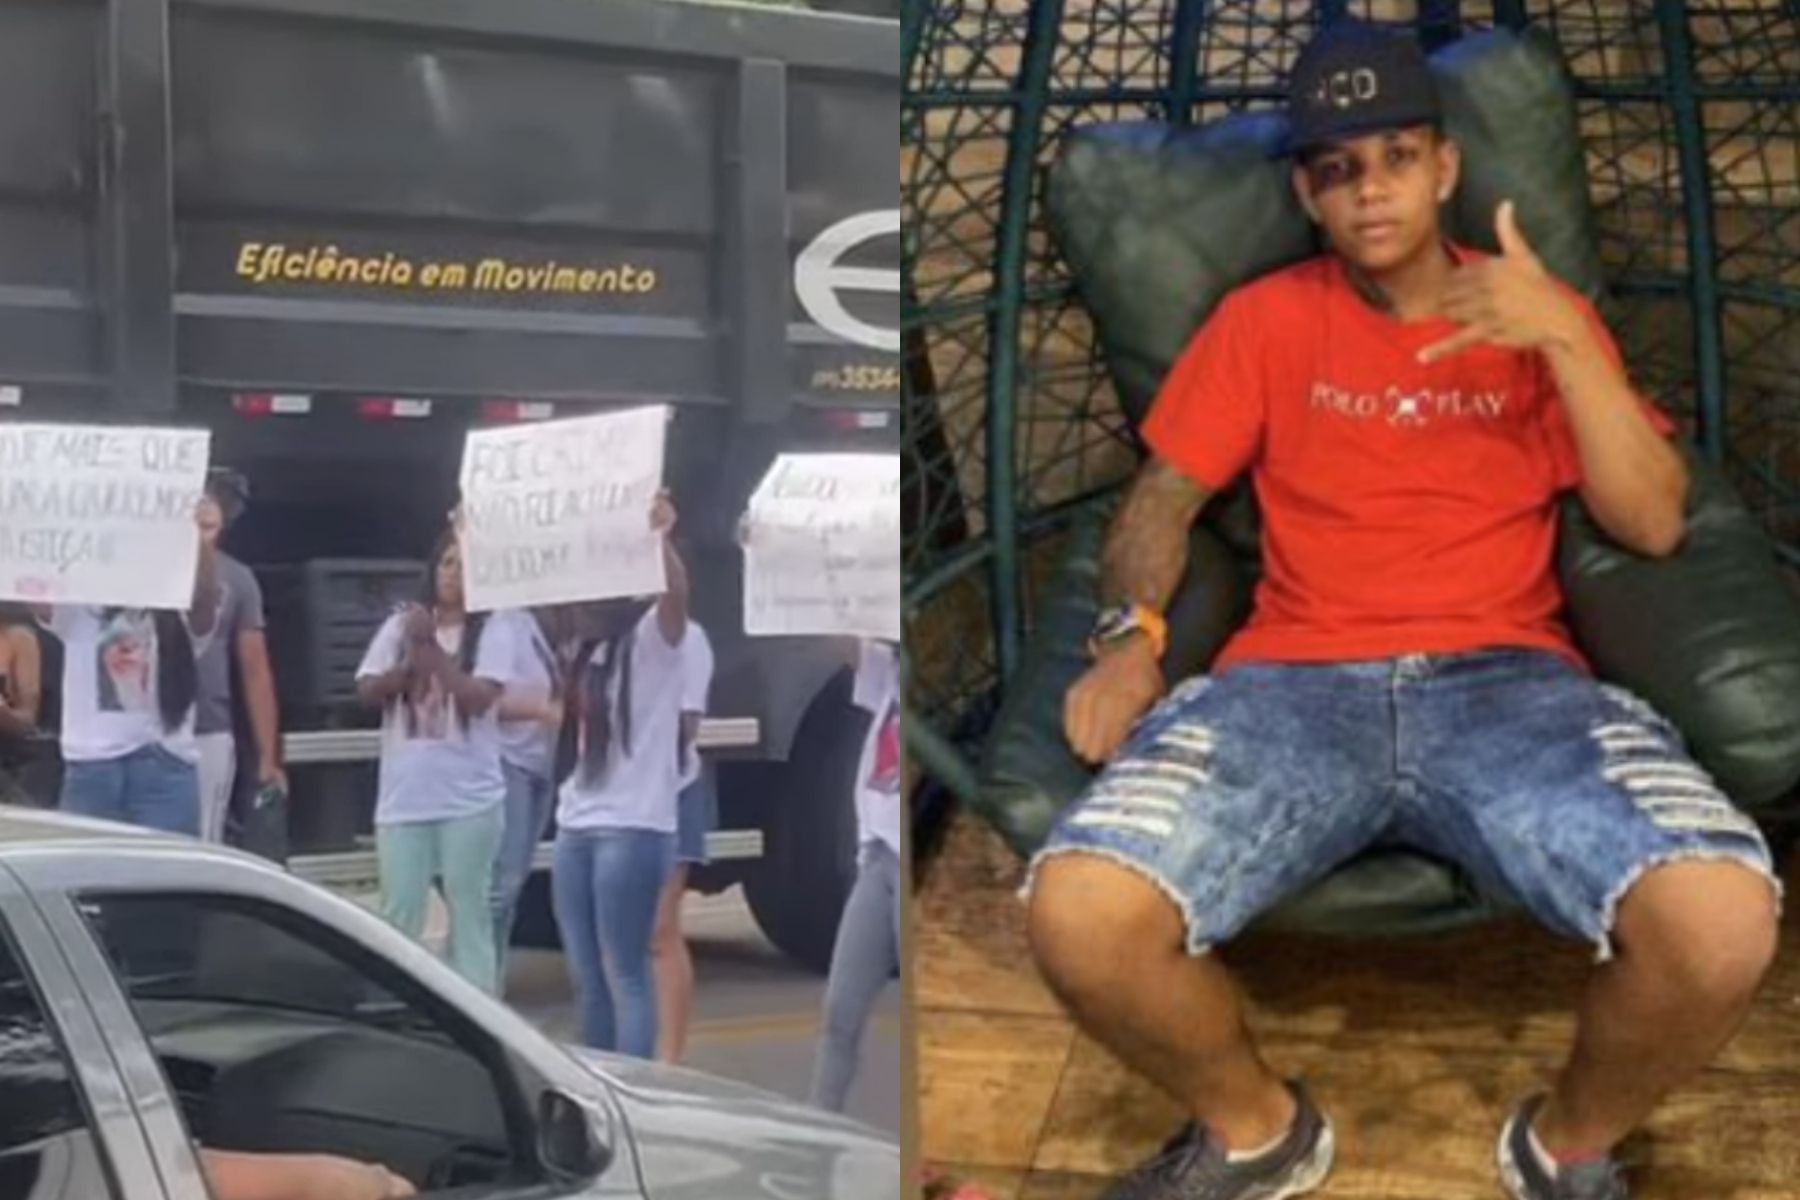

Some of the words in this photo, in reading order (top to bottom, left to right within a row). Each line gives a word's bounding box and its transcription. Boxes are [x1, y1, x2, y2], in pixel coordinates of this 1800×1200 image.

[236, 243, 412, 283] Eficiência
[420, 260, 467, 289] em
[472, 257, 657, 293] Movimento
[1310, 380, 1379, 417] POLO
[1436, 387, 1506, 417] PLAY
[141, 434, 197, 474] QUE
